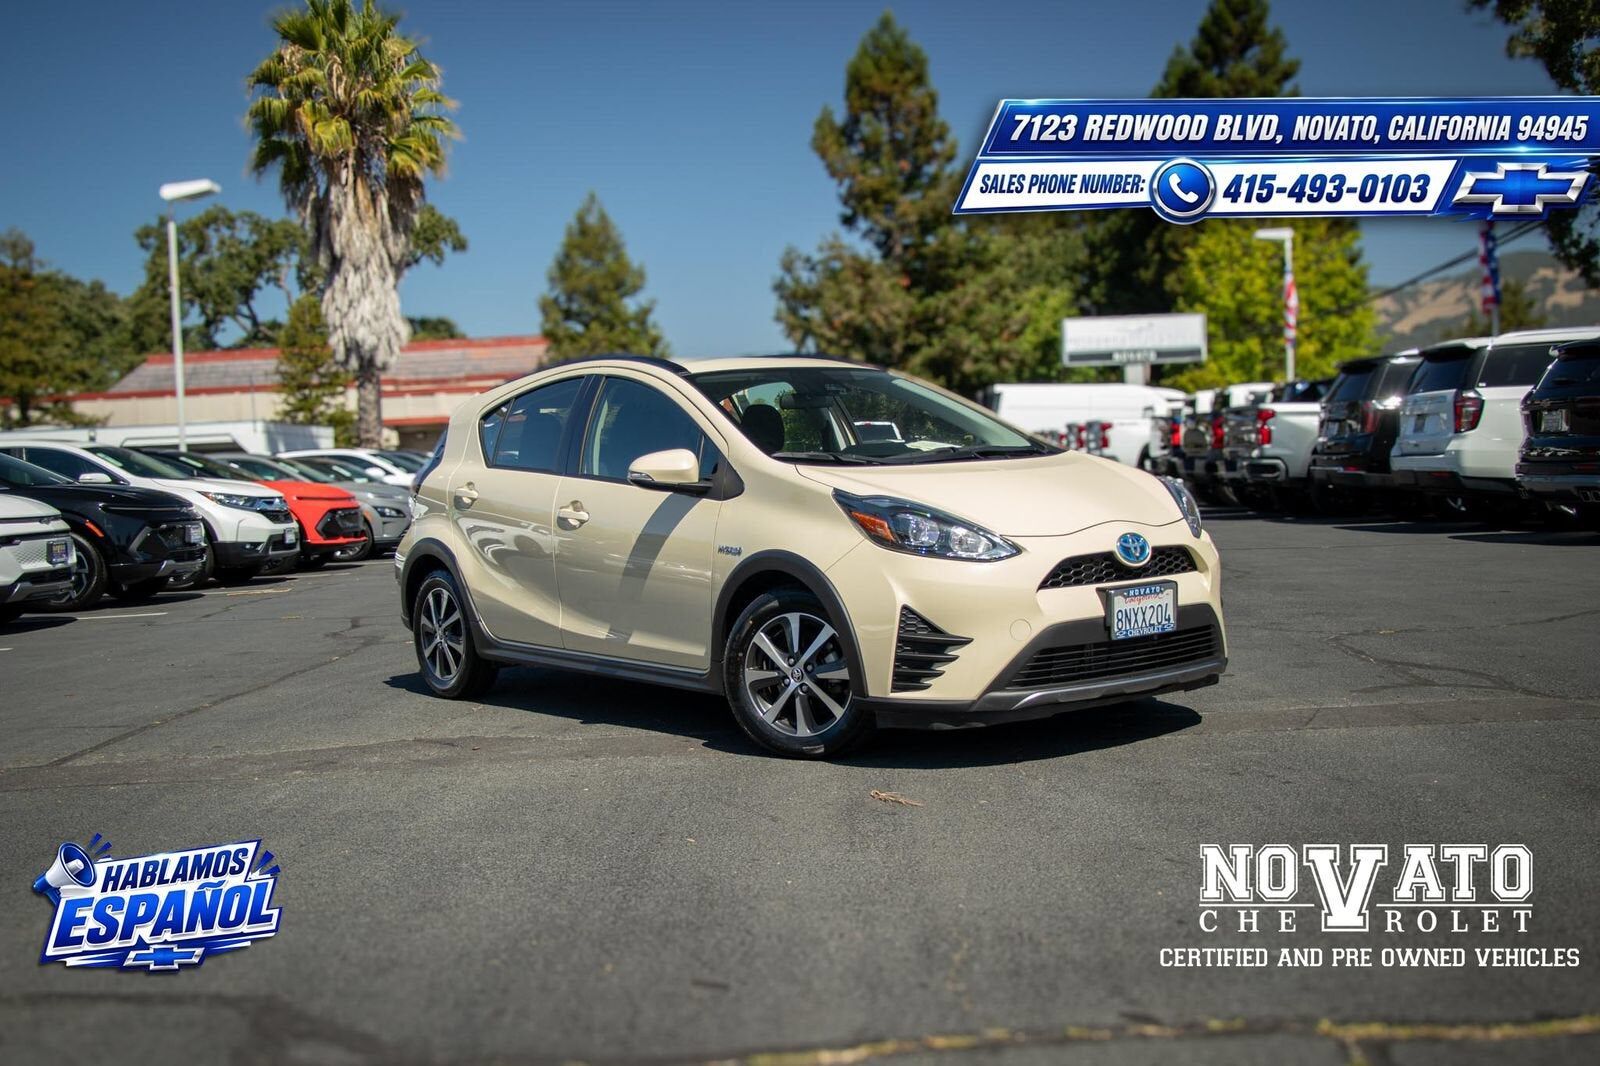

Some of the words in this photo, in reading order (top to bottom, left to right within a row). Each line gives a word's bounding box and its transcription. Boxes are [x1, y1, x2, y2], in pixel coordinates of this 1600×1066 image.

[1129, 586, 1160, 597] NOVATO
[1116, 602, 1171, 631] 8NXX204
[1128, 626, 1162, 636] CHEVROLET
